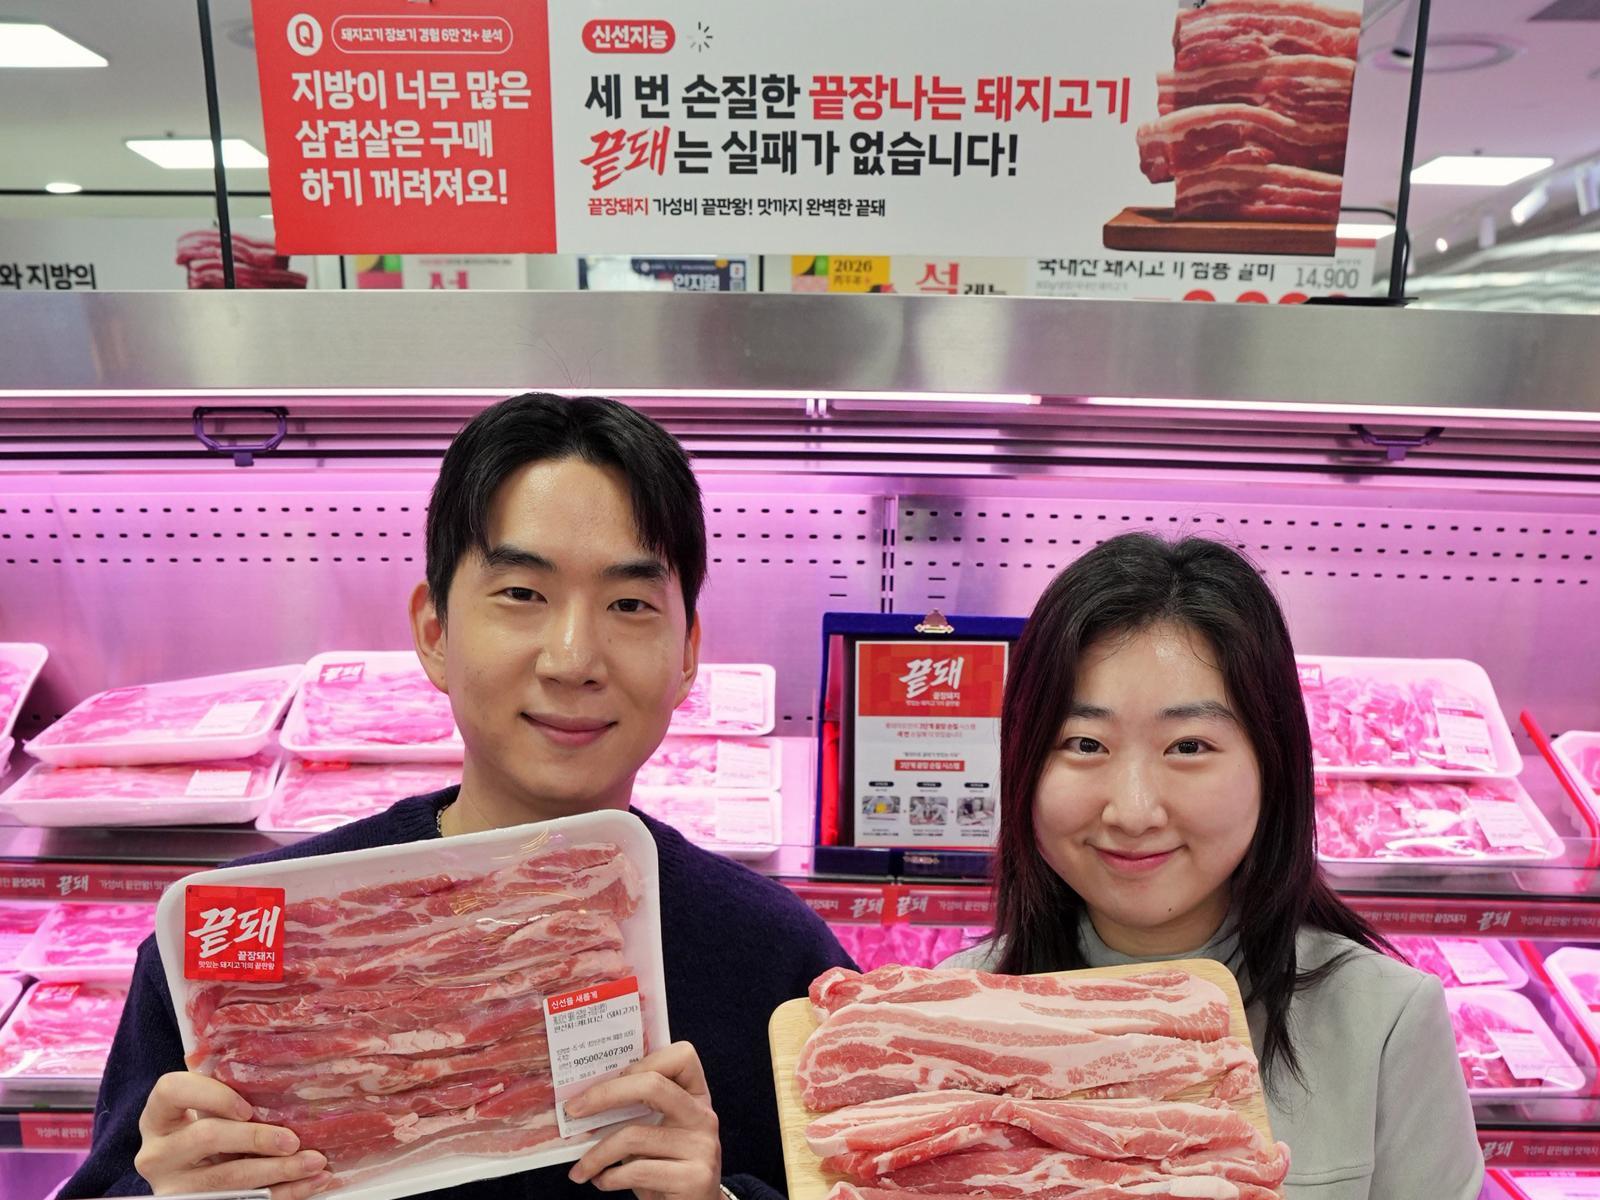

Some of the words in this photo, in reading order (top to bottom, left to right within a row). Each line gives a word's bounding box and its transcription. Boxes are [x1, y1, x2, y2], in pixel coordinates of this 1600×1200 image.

[340, 28, 384, 42] 돼지고기
[385, 28, 417, 42] 장보기
[419, 28, 440, 42] 경험
[481, 29, 503, 43] 분석
[592, 25, 668, 49] 신선지능
[291, 70, 387, 110] 지방이
[396, 70, 460, 110] 너무
[466, 70, 532, 110] 많은
[584, 74, 621, 119] 세
[634, 74, 670, 119] 번
[681, 74, 801, 119] 손질한
[809, 75, 966, 122] 끝장나는
[974, 75, 1130, 124] 돼지고기
[295, 120, 424, 158] 삼겹살은
[430, 120, 493, 158] 구매
[580, 125, 712, 191] 끝돼는
[721, 130, 840, 176] 실패가
[850, 130, 1018, 178] 없습니다!
[300, 167, 363, 206] 하기
[370, 167, 508, 206] 꺼려져요!
[588, 198, 648, 216] 끝장돼지
[653, 198, 698, 216] 가성비
[701, 198, 752, 216] 끝판왕!
[757, 198, 802, 216] 맛까지
[806, 198, 852, 217] 완벽한
[855, 199, 886, 217] 끝돼
[28, 263, 97, 290] 지방의
[833, 260, 872, 273] 2026
[1295, 266, 1359, 289] 14,900
[898, 656, 965, 698] 끝돼
[188, 905, 281, 958] 끝돼
[237, 951, 275, 961] 끝장돼지
[551, 995, 574, 1009] 신선을
[576, 990, 598, 1004] 새롭게
[573, 1043, 634, 1067] 905002407309
